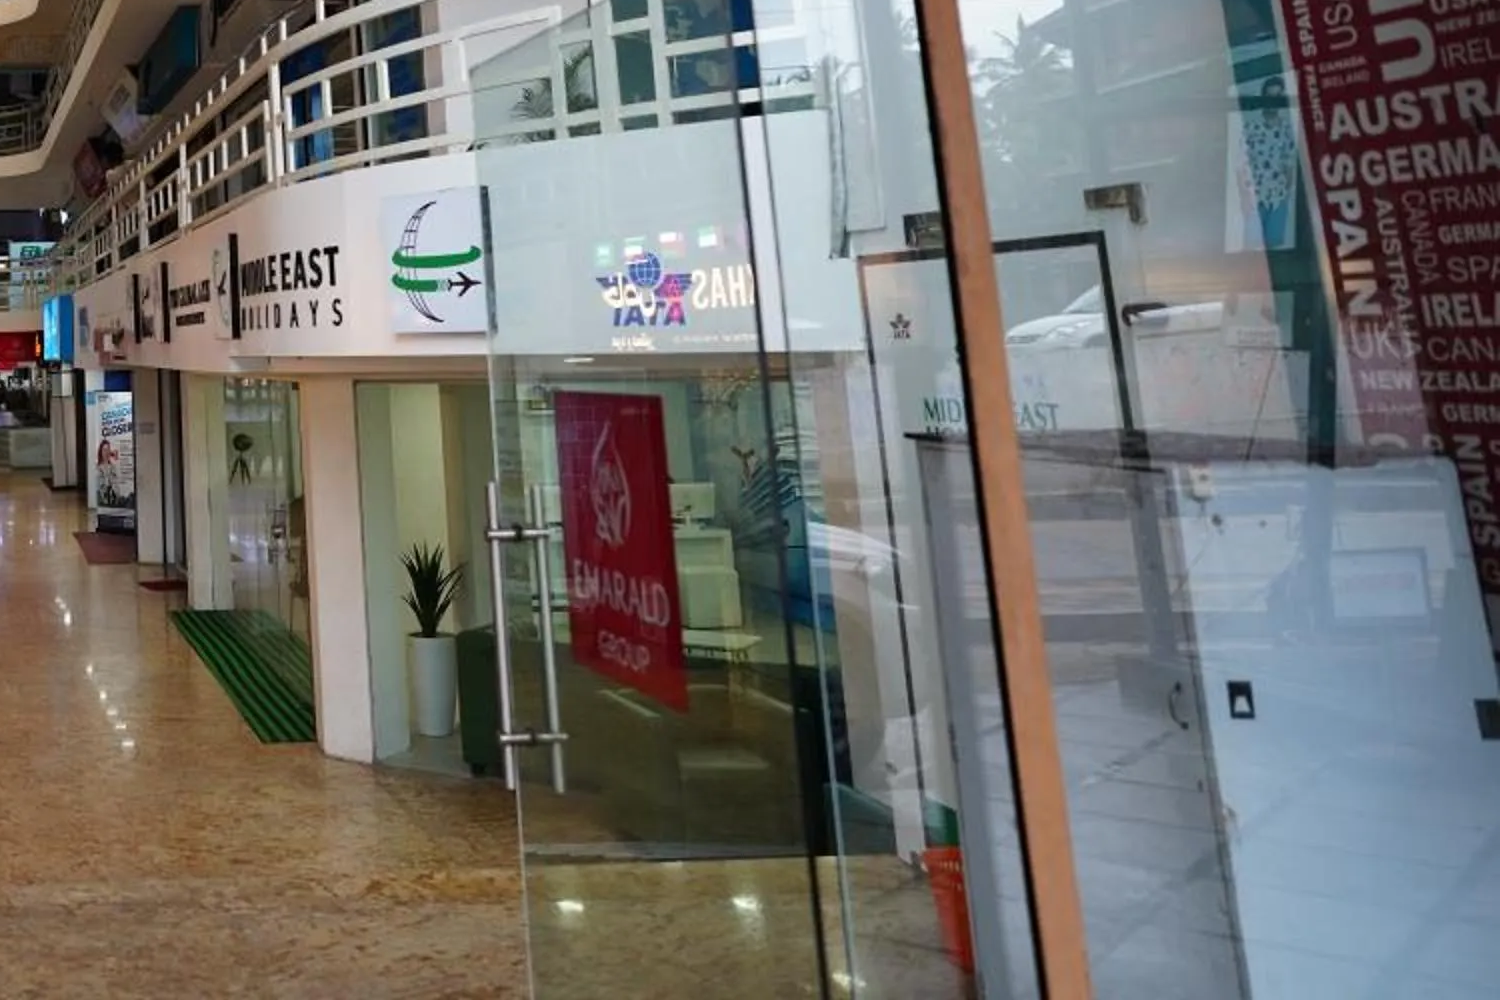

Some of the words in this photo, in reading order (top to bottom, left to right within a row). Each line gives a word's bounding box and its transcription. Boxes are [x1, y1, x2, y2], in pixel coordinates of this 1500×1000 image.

[1329, 76, 1500, 142] AUSTR
[1319, 152, 1383, 317] SPAIN
[281, 246, 340, 291] EAST
[241, 298, 344, 331] HOLIDAYS
[1359, 369, 1413, 391] NEW
[573, 557, 671, 628] EMARALD
